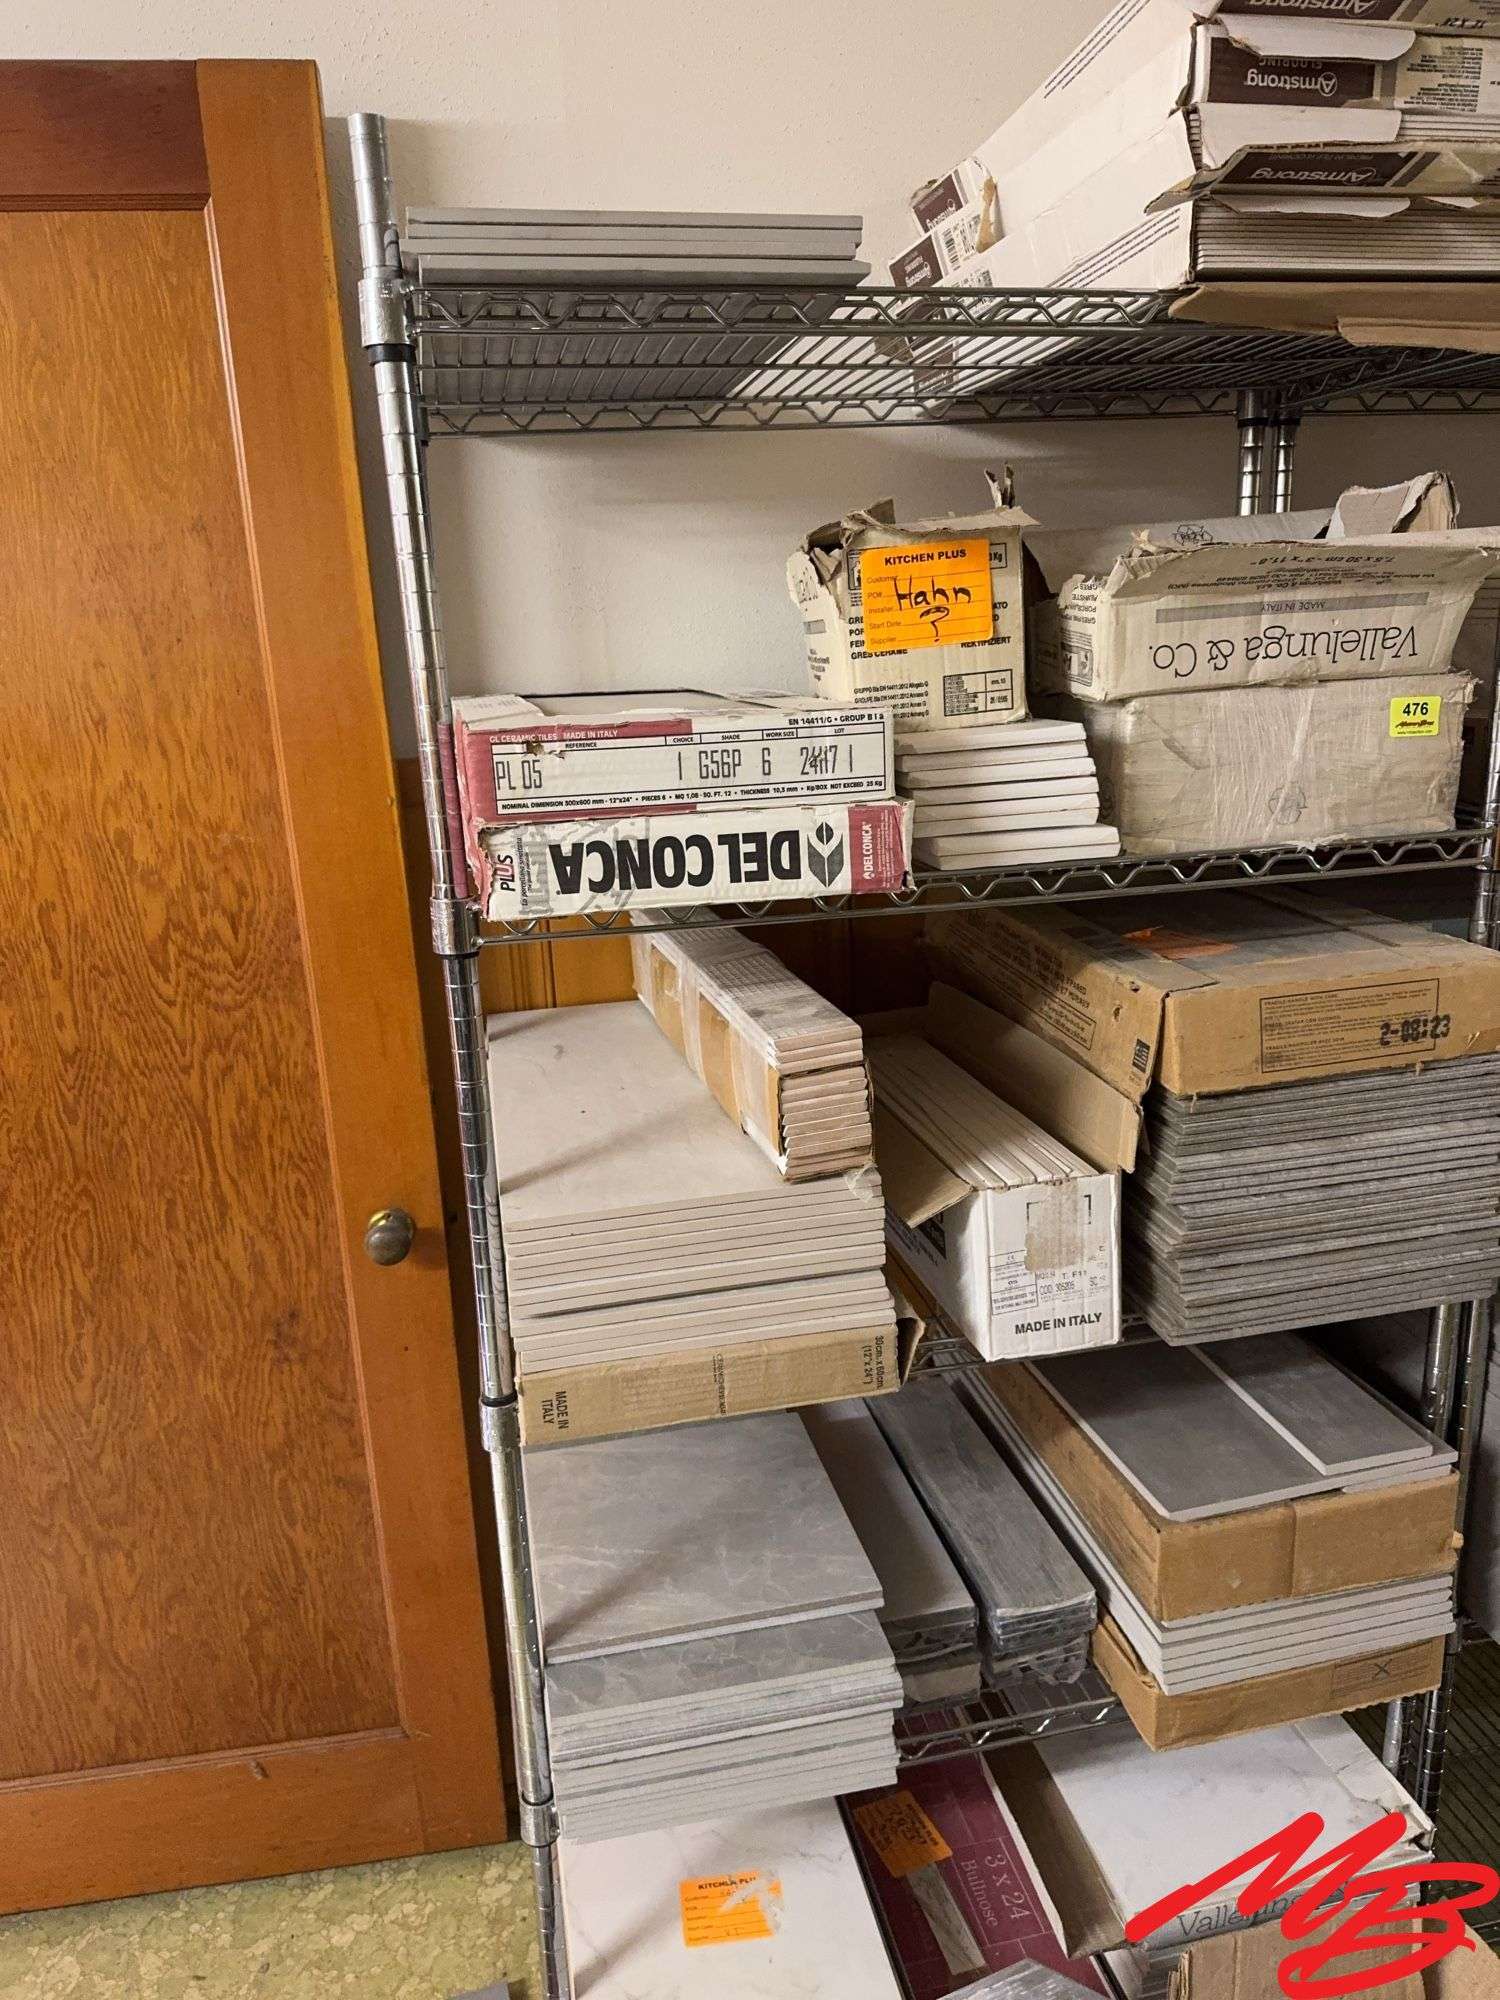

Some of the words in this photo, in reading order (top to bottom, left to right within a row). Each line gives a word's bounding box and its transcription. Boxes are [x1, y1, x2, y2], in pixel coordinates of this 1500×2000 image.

[1247, 69, 1337, 97] Armstrong
[1250, 167, 1376, 185] Armstrong
[885, 552, 935, 566] KITCHEN
[938, 548, 967, 560] PLUS
[894, 575, 971, 611] Hahn
[1299, 600, 1327, 610] MADE
[1284, 601, 1295, 610] IN
[1206, 639, 1234, 671] &
[1244, 625, 1418, 663] Vallelunga
[1148, 643, 1197, 678] Co.
[788, 718, 799, 726] EN
[839, 714, 866, 722] GROUP
[1403, 702, 1429, 716] 476
[501, 733, 536, 743] CERAMIC
[537, 732, 558, 742] TILES
[563, 732, 586, 740] MADE
[587, 731, 596, 739] IN
[597, 730, 618, 738] ITALY
[672, 736, 694, 744] CHOICE
[721, 733, 741, 741] SHADE
[495, 760, 515, 790] PL
[521, 759, 542, 790] 05
[501, 802, 529, 810] NOMINAL
[531, 800, 564, 809] DIMENSION
[641, 794, 660, 802] PIECES
[702, 791, 713, 799] SQ.
[714, 790, 723, 798] FT.
[724, 789, 732, 797] 12
[740, 788, 770, 796] THICKNESS
[830, 783, 843, 791] NOT
[844, 782, 864, 790] EXCEED
[866, 780, 873, 788] 25
[874, 780, 883, 789] Kg
[497, 854, 516, 892] PLUS
[1015, 1318, 1050, 1335] MADE
[1053, 1316, 1066, 1332] IN
[1068, 1312, 1103, 1329] ITALY
[541, 1399, 554, 1424] ITALY
[555, 1391, 568, 1417] MADE
[558, 1420, 569, 1429] IN
[985, 1853, 1005, 1868] 3
[993, 1874, 1006, 1885] x
[960, 1859, 998, 1927] Bullnose
[1000, 1891, 1030, 1919] 24
